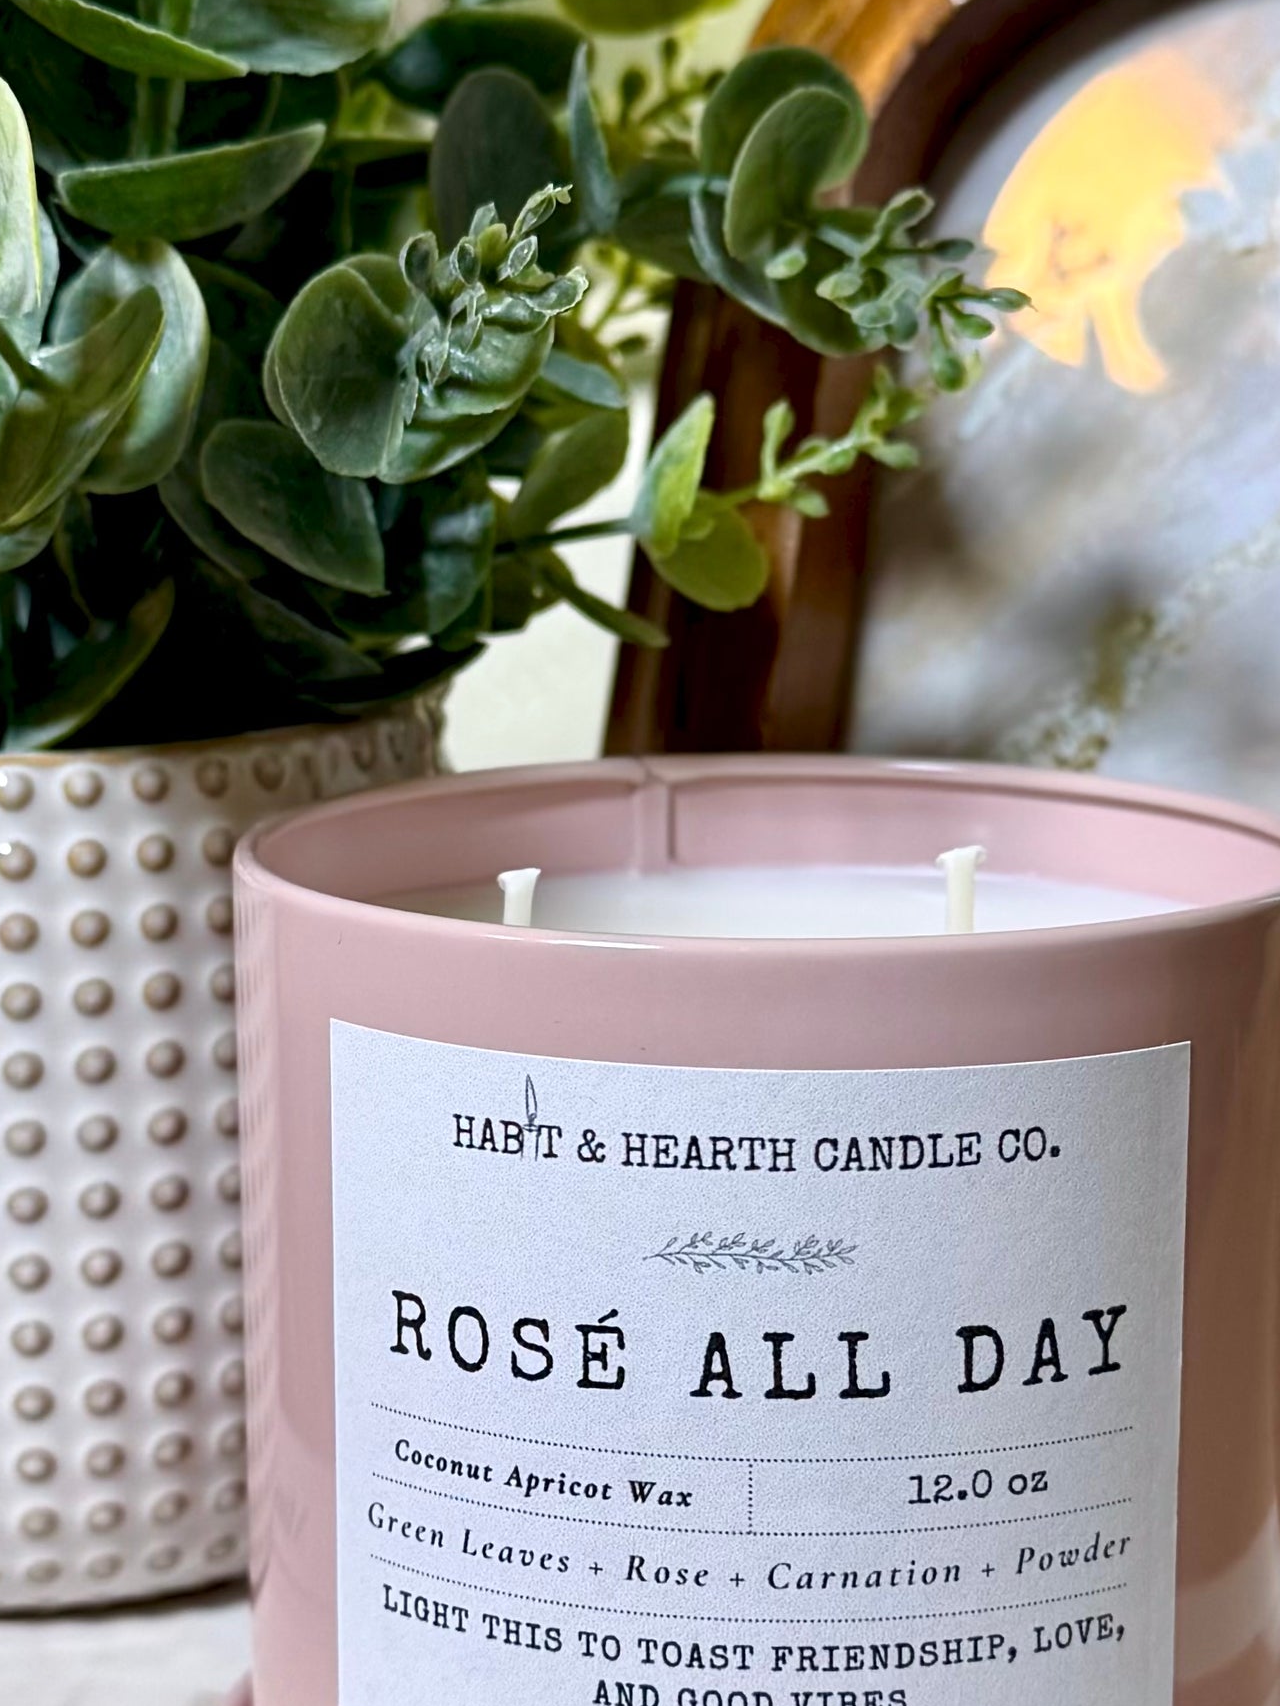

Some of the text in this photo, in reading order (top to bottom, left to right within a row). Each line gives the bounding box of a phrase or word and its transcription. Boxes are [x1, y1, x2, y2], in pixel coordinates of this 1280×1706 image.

[576, 1128, 607, 1164] &
[621, 1132, 797, 1173] HEARTH
[814, 1131, 982, 1172] CANDLE
[997, 1125, 1061, 1164] CO.
[389, 1289, 1128, 1401] ROSÉ ALL DAY
[394, 1438, 693, 1508] Coconut Apricot Wax
[907, 1469, 1049, 1505] 12.0 oz
[368, 1502, 1131, 1590] Green Leaves + Rose + Carnation + Powder
[382, 1583, 1125, 1672] LIGHT THIS TO TOAST FRIENDSHIP, LOVE,
